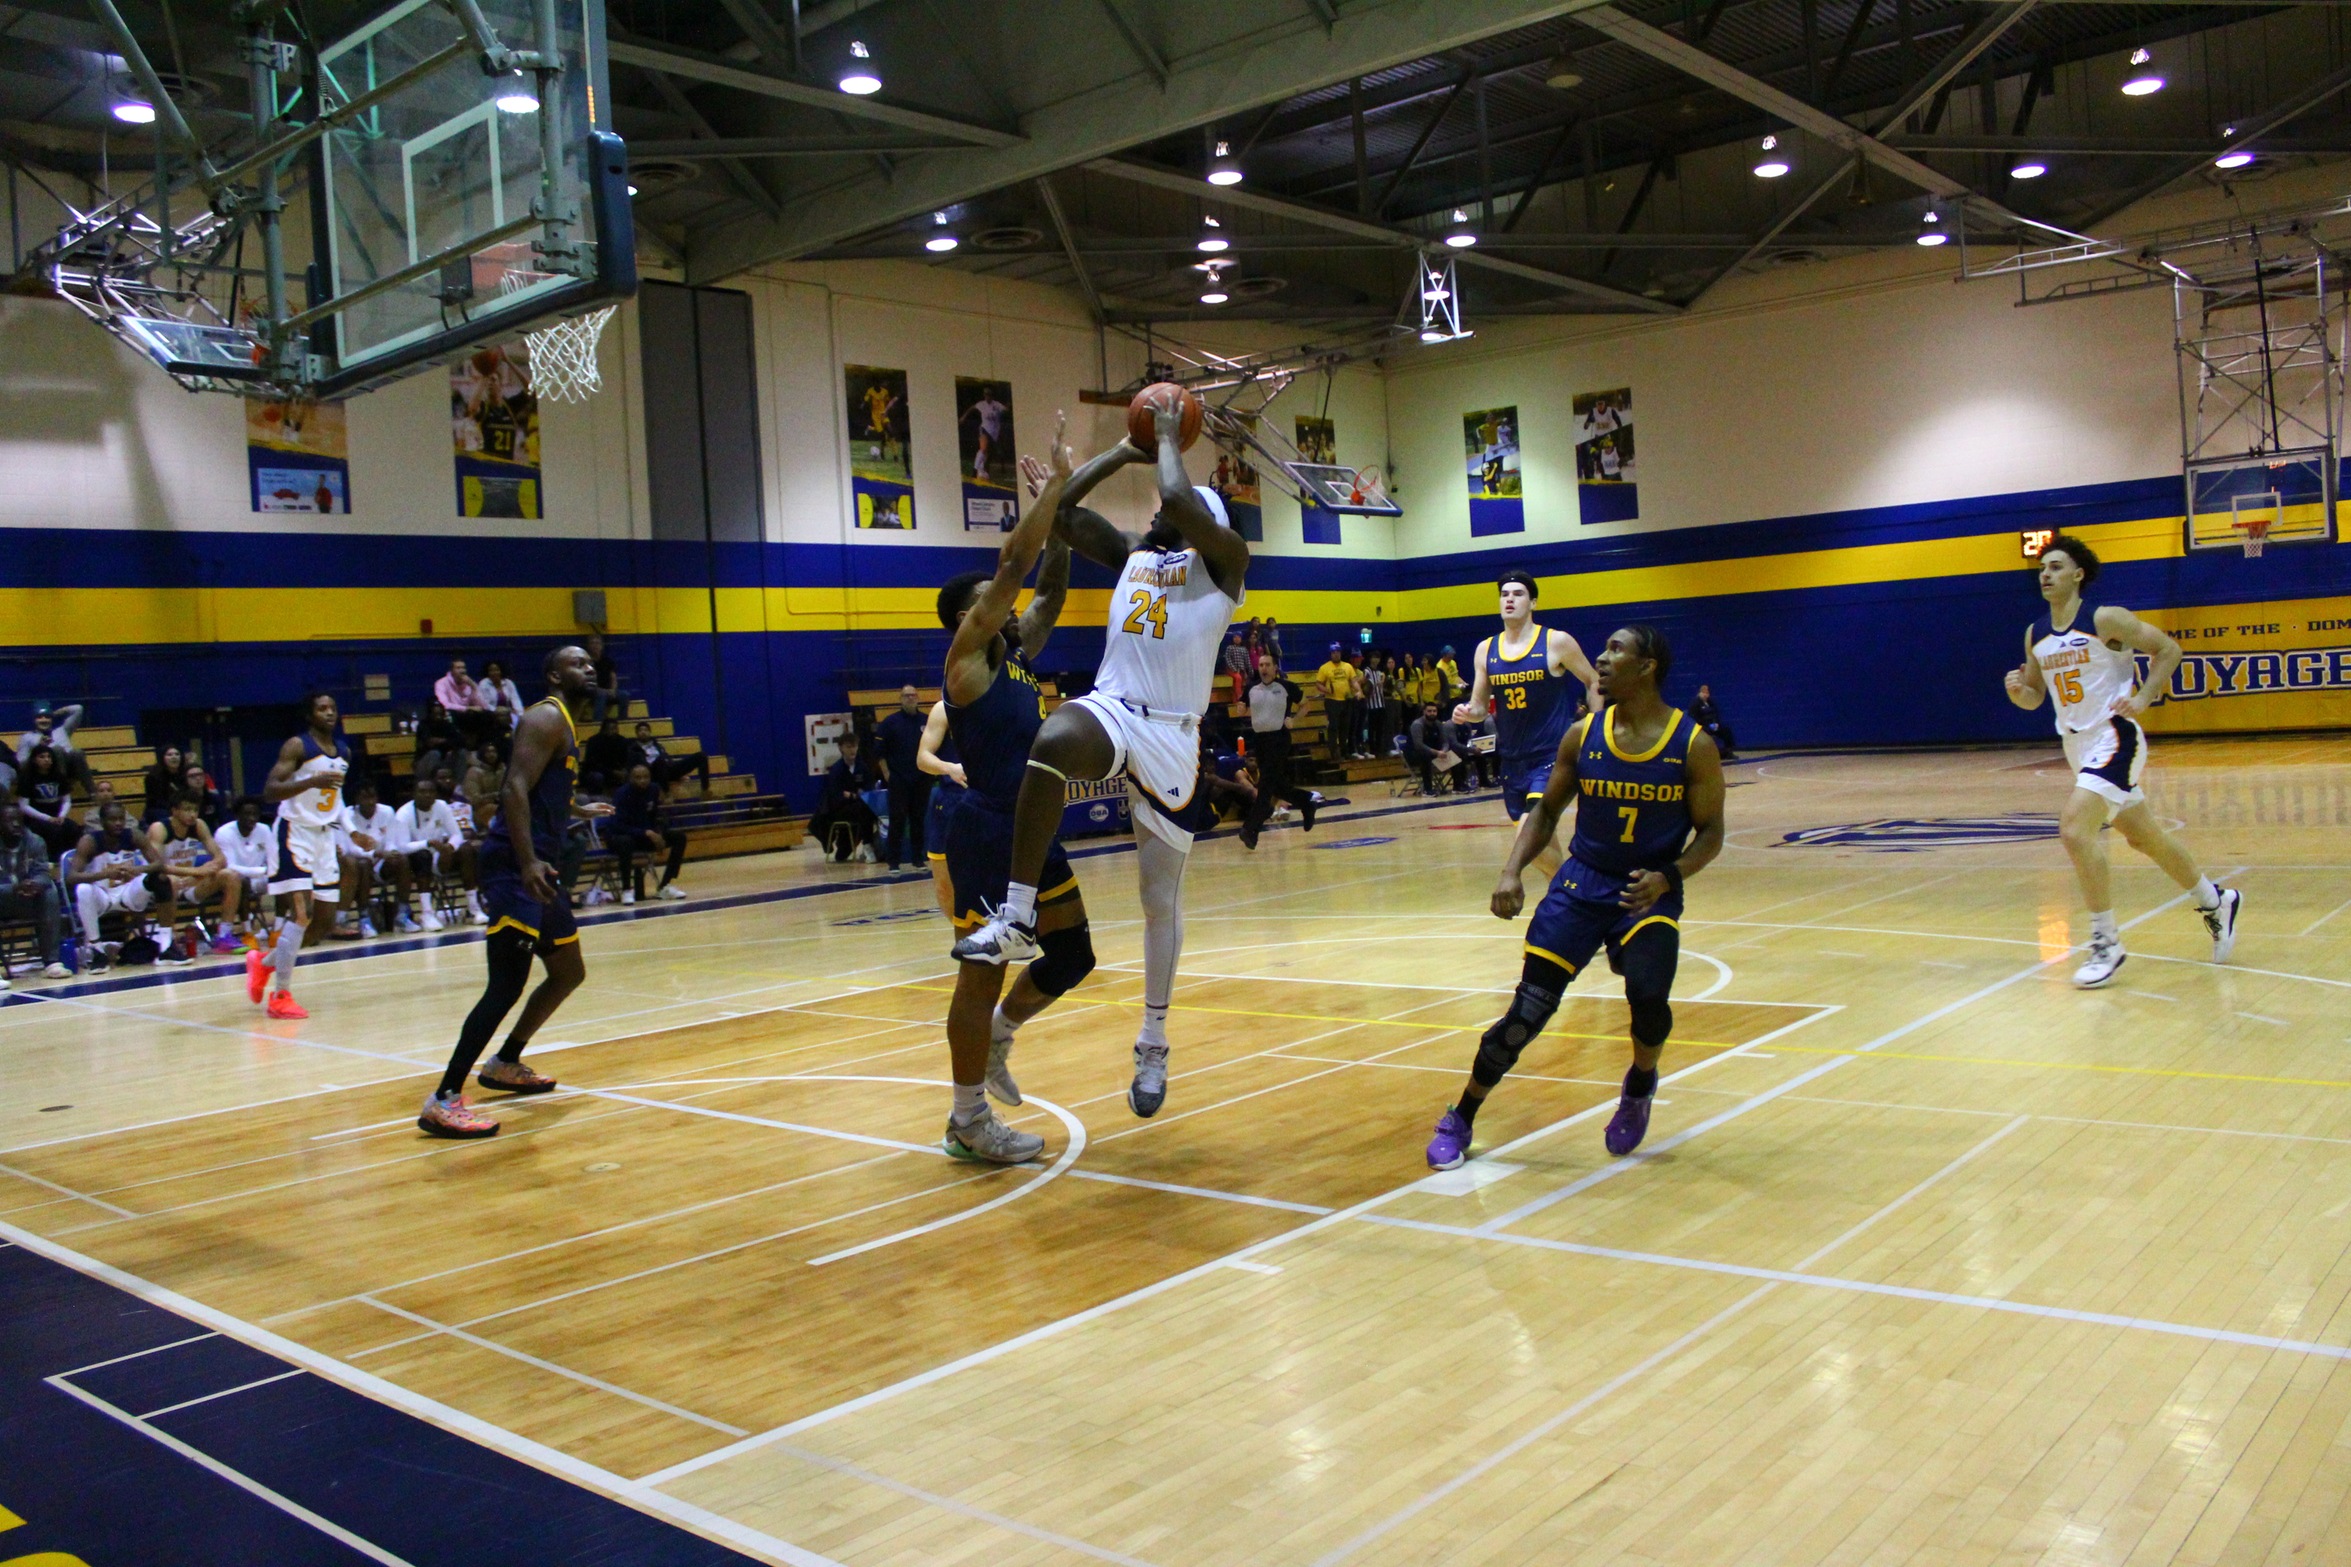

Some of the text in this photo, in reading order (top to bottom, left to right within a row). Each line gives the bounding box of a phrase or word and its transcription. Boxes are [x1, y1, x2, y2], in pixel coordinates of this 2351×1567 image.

[1122, 589, 1168, 640] 24
[2203, 626, 2230, 639] OF
[2238, 623, 2281, 636] THE
[1504, 687, 1528, 710] 32
[2053, 668, 2085, 707] 15
[317, 788, 338, 812] 3
[1068, 777, 1128, 801] OYAGE
[1579, 778, 1685, 802] WINDSOR
[1617, 805, 1639, 843] 7
